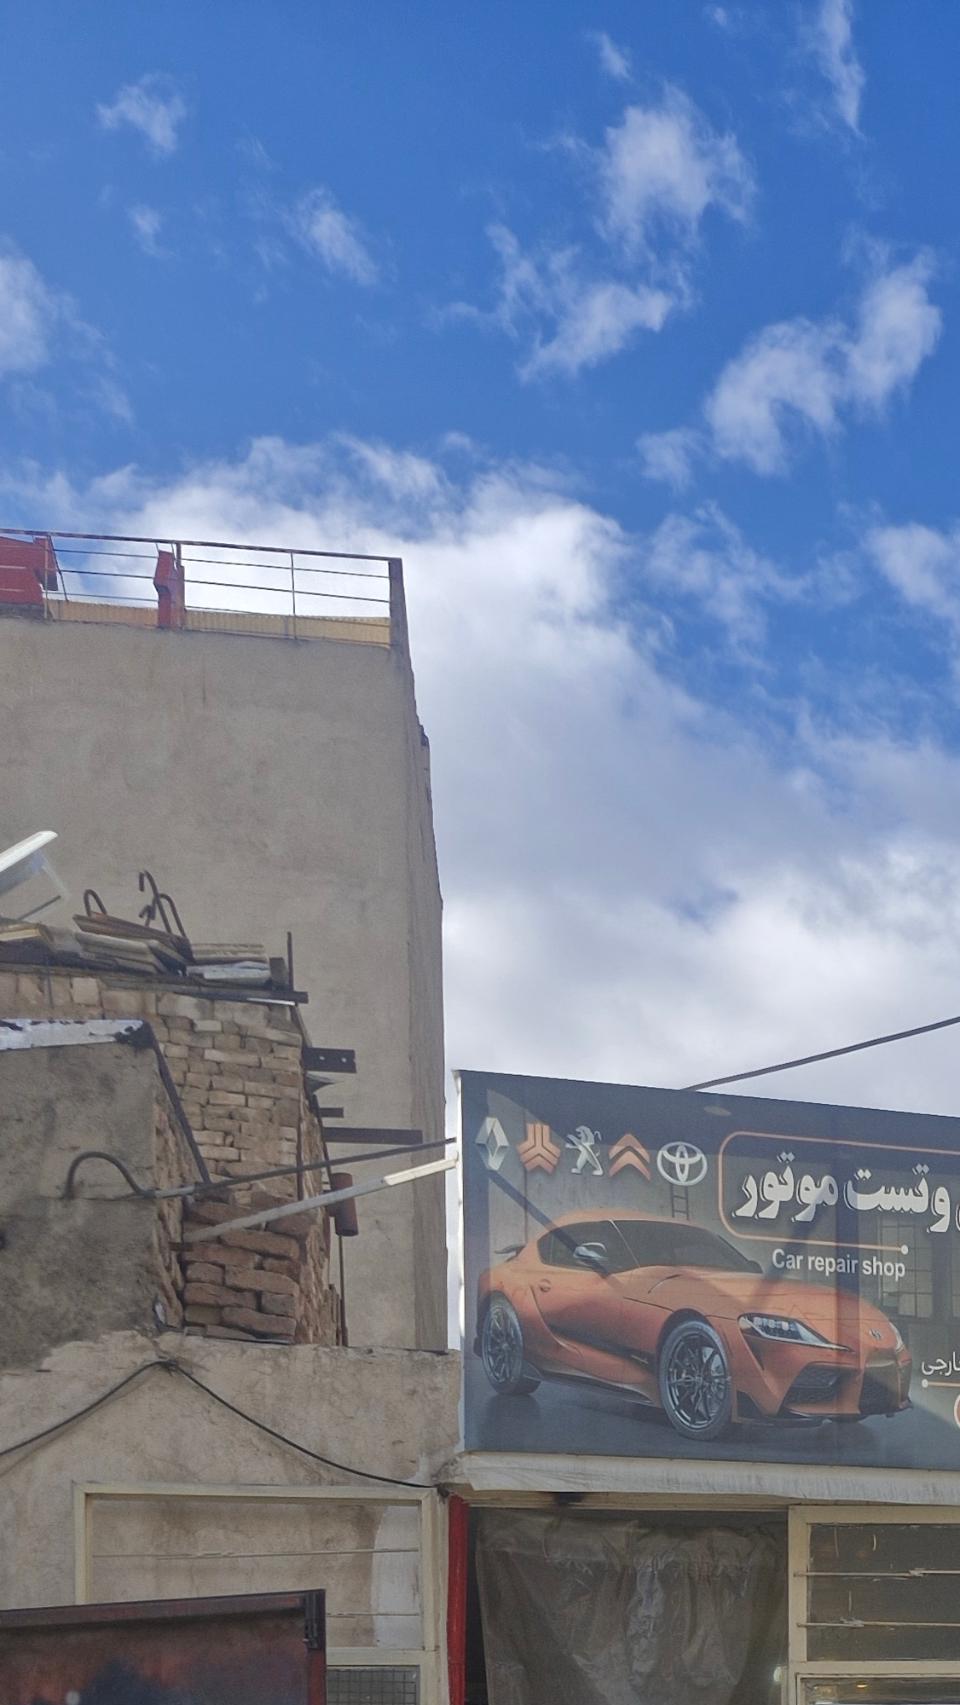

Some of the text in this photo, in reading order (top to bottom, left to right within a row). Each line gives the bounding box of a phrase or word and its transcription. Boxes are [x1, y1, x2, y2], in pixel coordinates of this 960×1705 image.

[731, 1152, 840, 1222] موتور
[772, 1248, 906, 1282] Car repair shop
